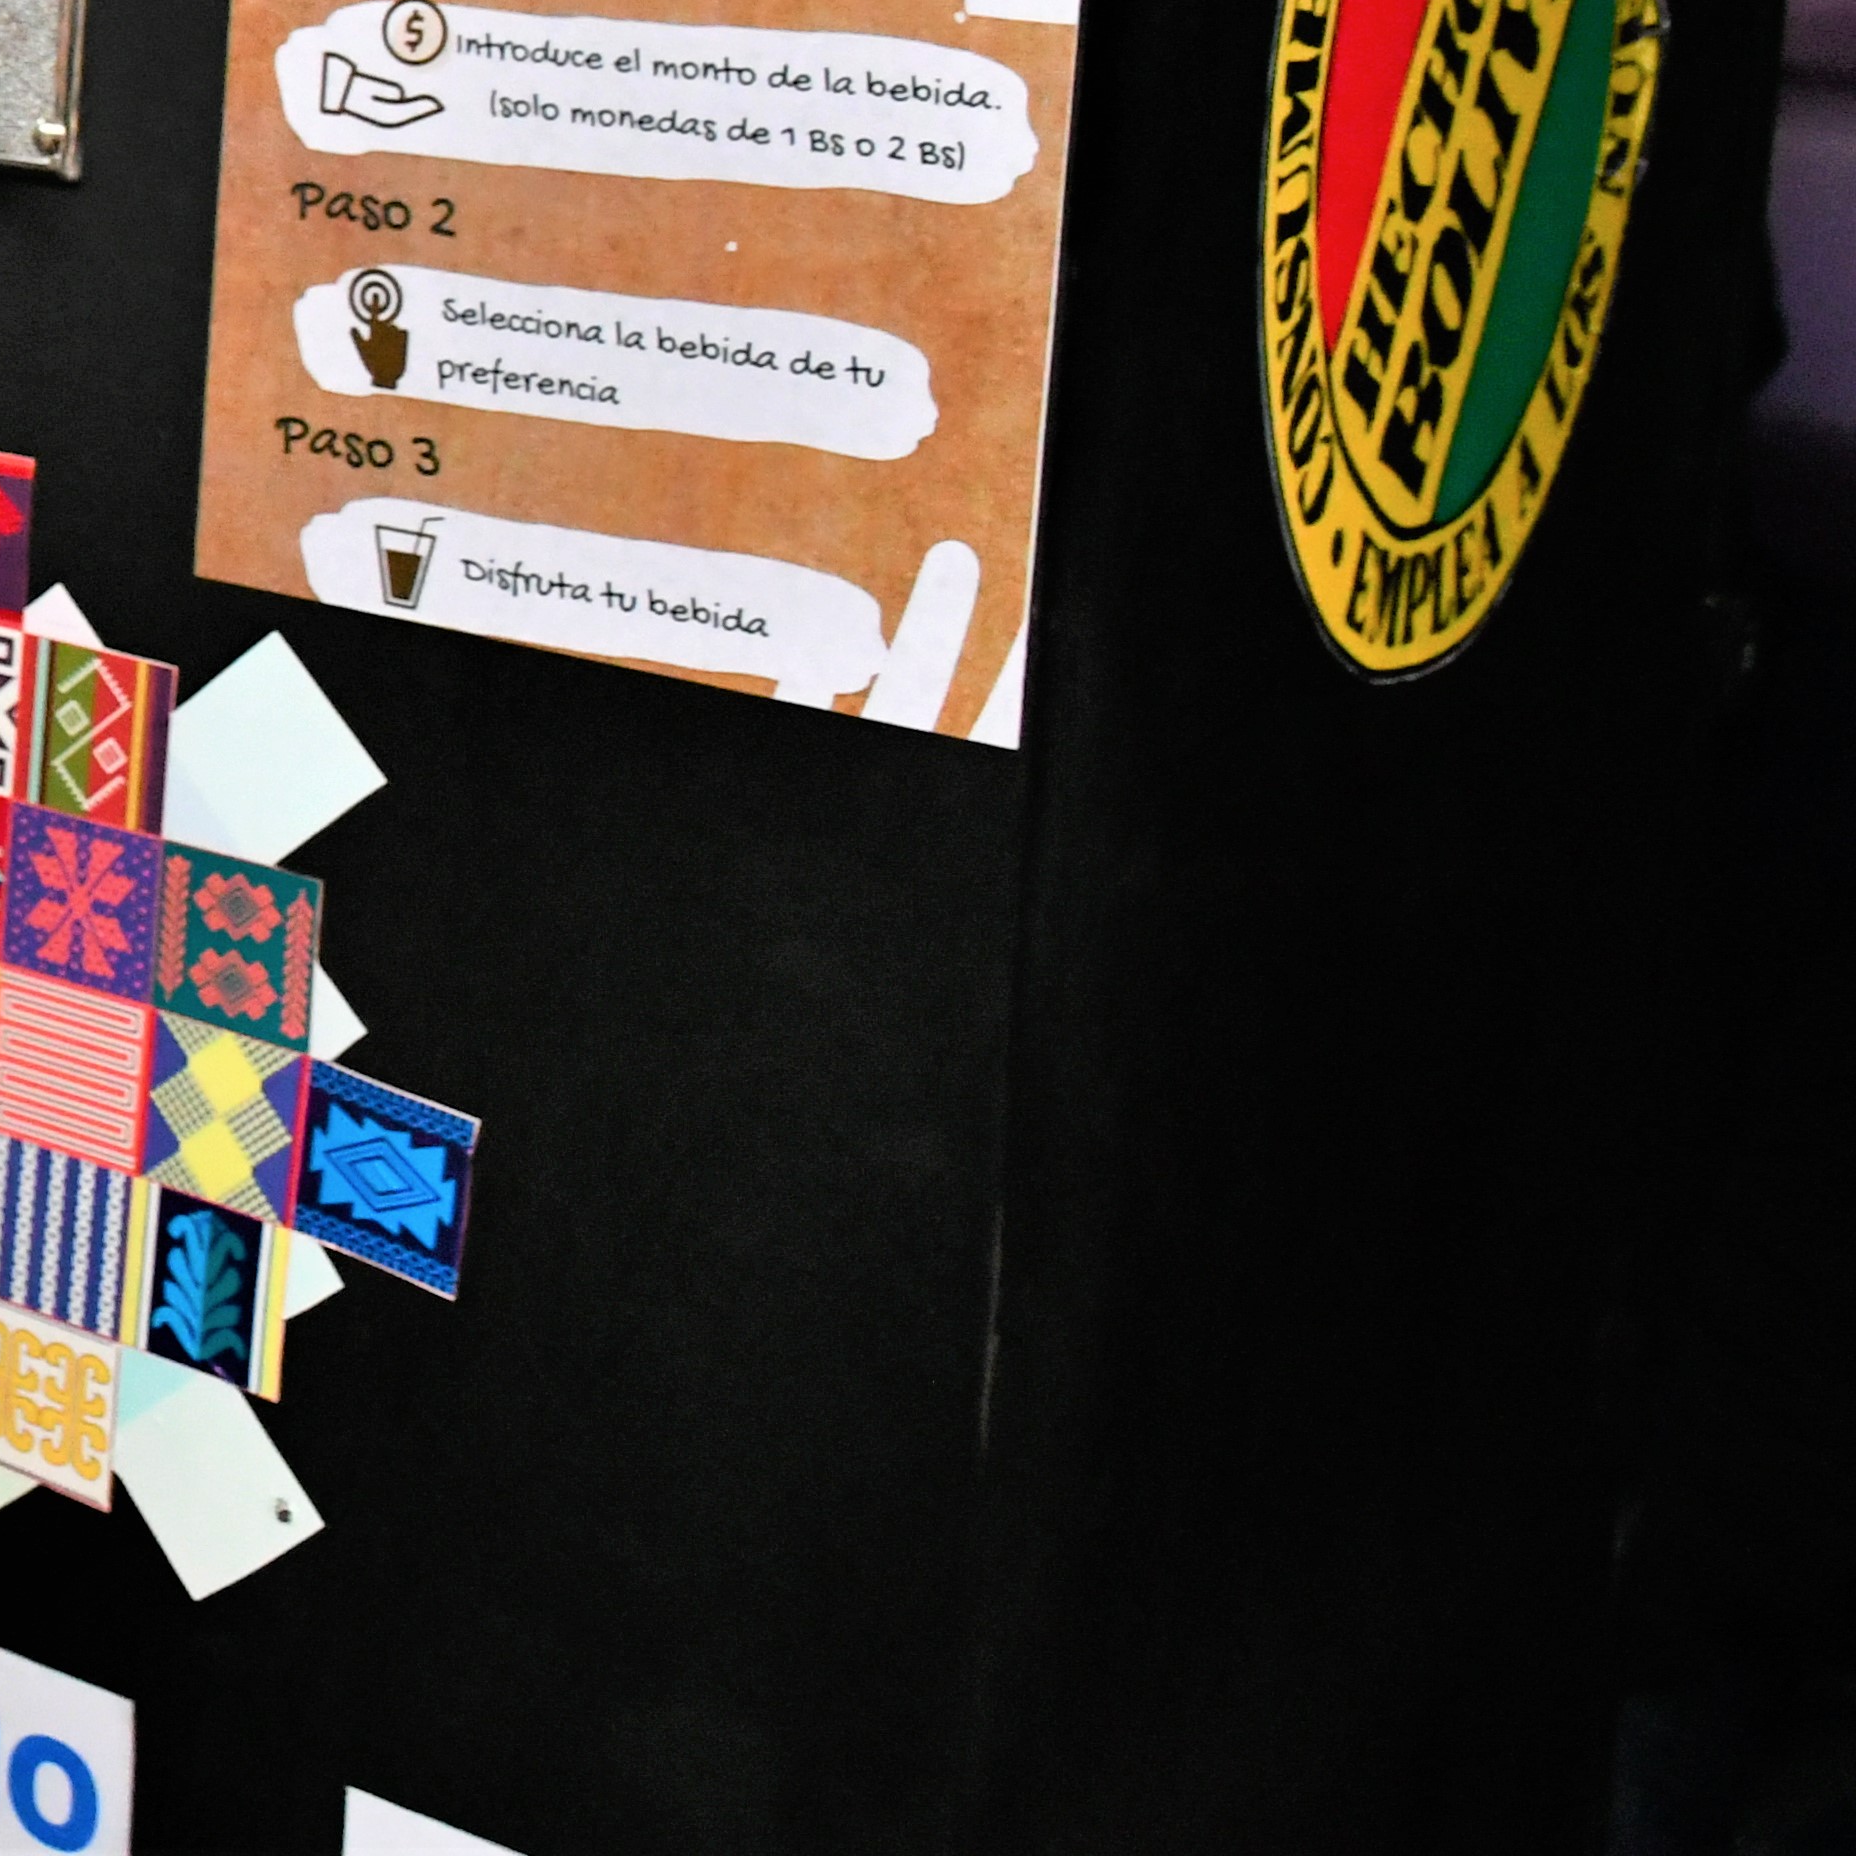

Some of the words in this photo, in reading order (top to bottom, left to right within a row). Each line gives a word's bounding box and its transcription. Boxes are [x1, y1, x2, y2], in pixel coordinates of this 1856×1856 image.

[457, 33, 604, 70] Introduce
[613, 48, 641, 73] el
[652, 56, 756, 85] monto
[767, 64, 813, 92] de
[824, 67, 856, 95] la
[866, 71, 1002, 110] bebida.
[490, 89, 560, 120] (solo
[570, 110, 718, 142] monedas
[726, 118, 771, 144] de
[780, 128, 796, 145] 1
[887, 136, 907, 161] 2
[290, 182, 411, 231] Paso
[429, 197, 458, 237] 2
[441, 297, 606, 345] Selecciona
[615, 320, 646, 350] la
[656, 327, 780, 372] bebida
[789, 350, 836, 381] de
[844, 355, 887, 388] tu
[436, 355, 621, 406] preferencia
[273, 416, 395, 470] Paso
[413, 436, 443, 476] 3
[459, 558, 593, 603] Disfruta
[599, 581, 637, 612] tu
[647, 589, 770, 638] bebida
[1345, 501, 1502, 648] EMPLEA
